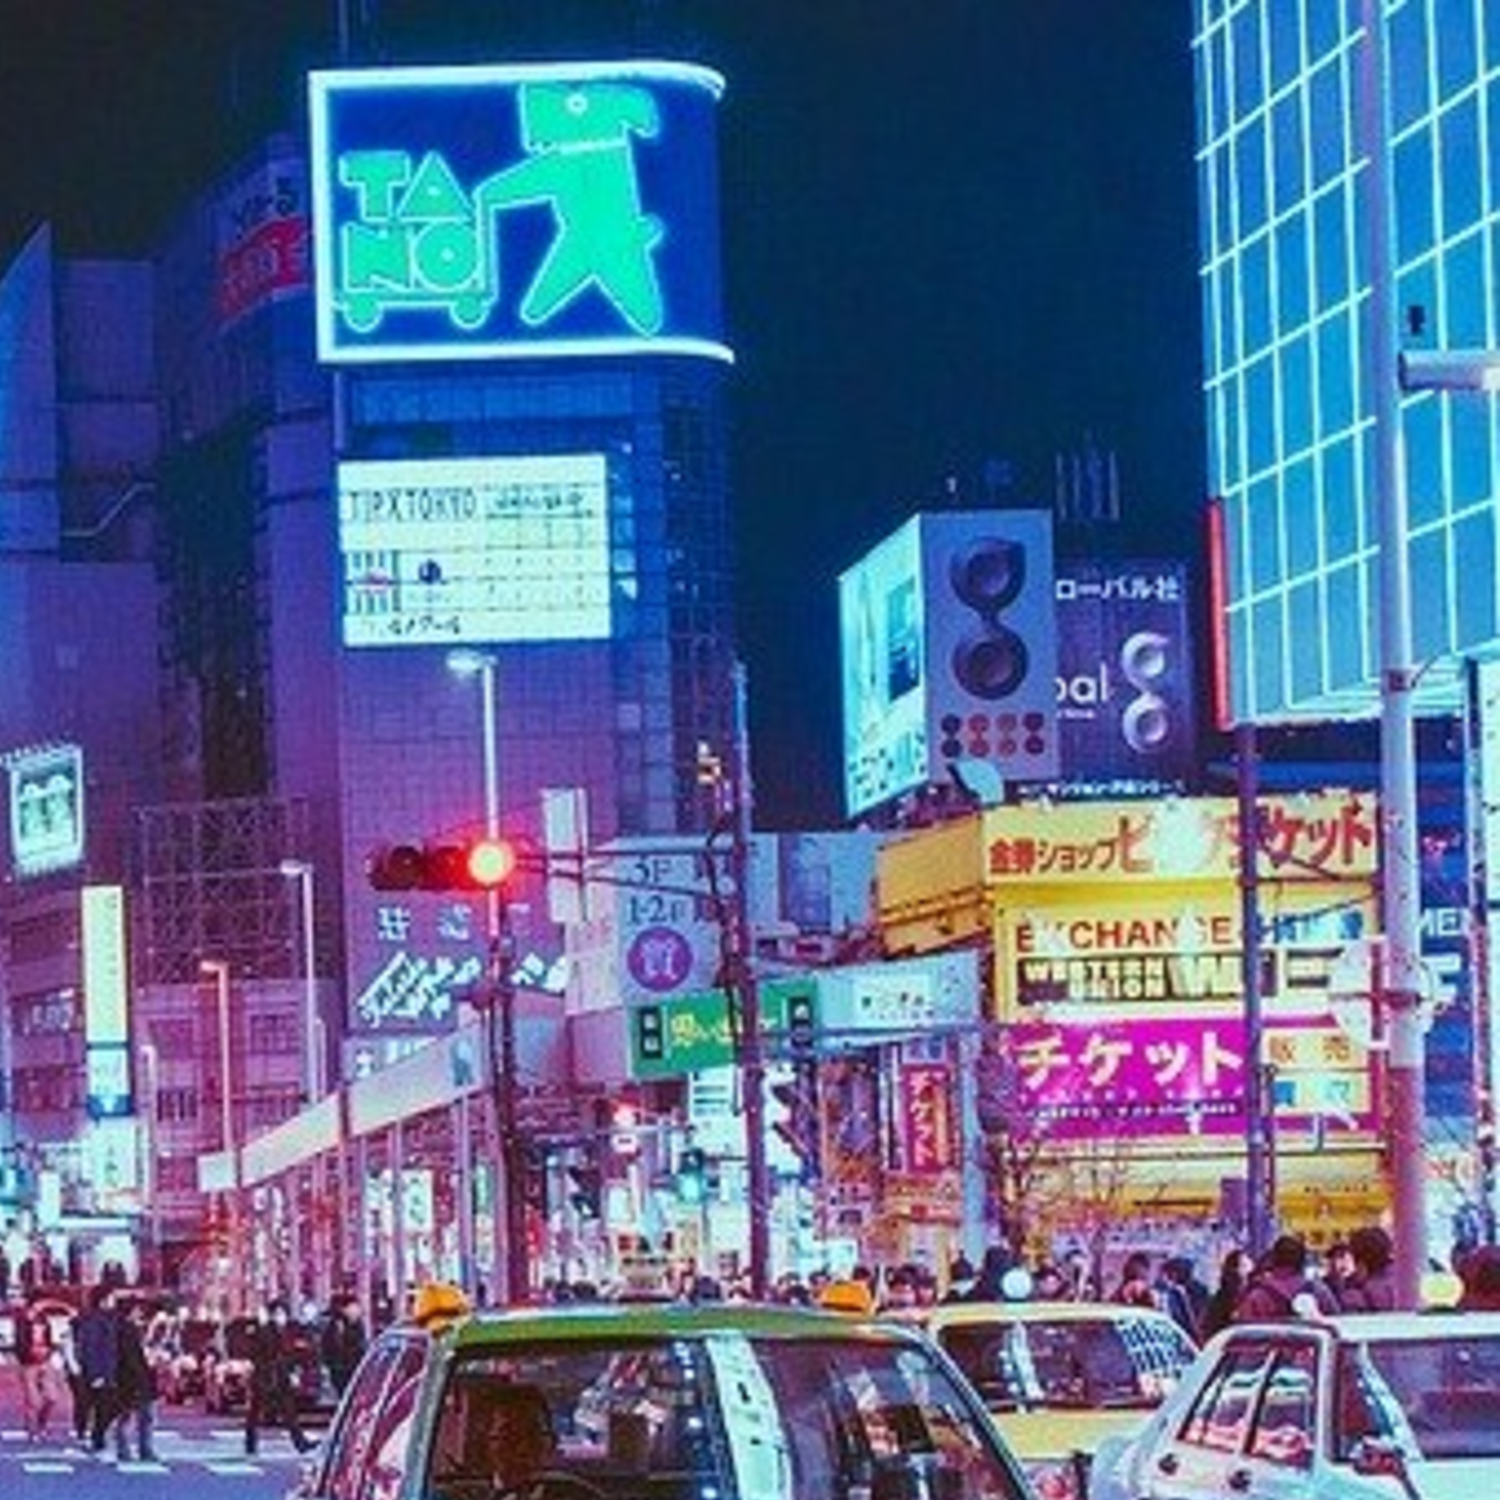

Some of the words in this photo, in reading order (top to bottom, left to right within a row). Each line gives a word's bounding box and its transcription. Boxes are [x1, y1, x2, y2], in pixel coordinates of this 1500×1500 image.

[338, 149, 475, 222] TA
[342, 219, 486, 293] NO
[1017, 1030, 1243, 1089] チケット
